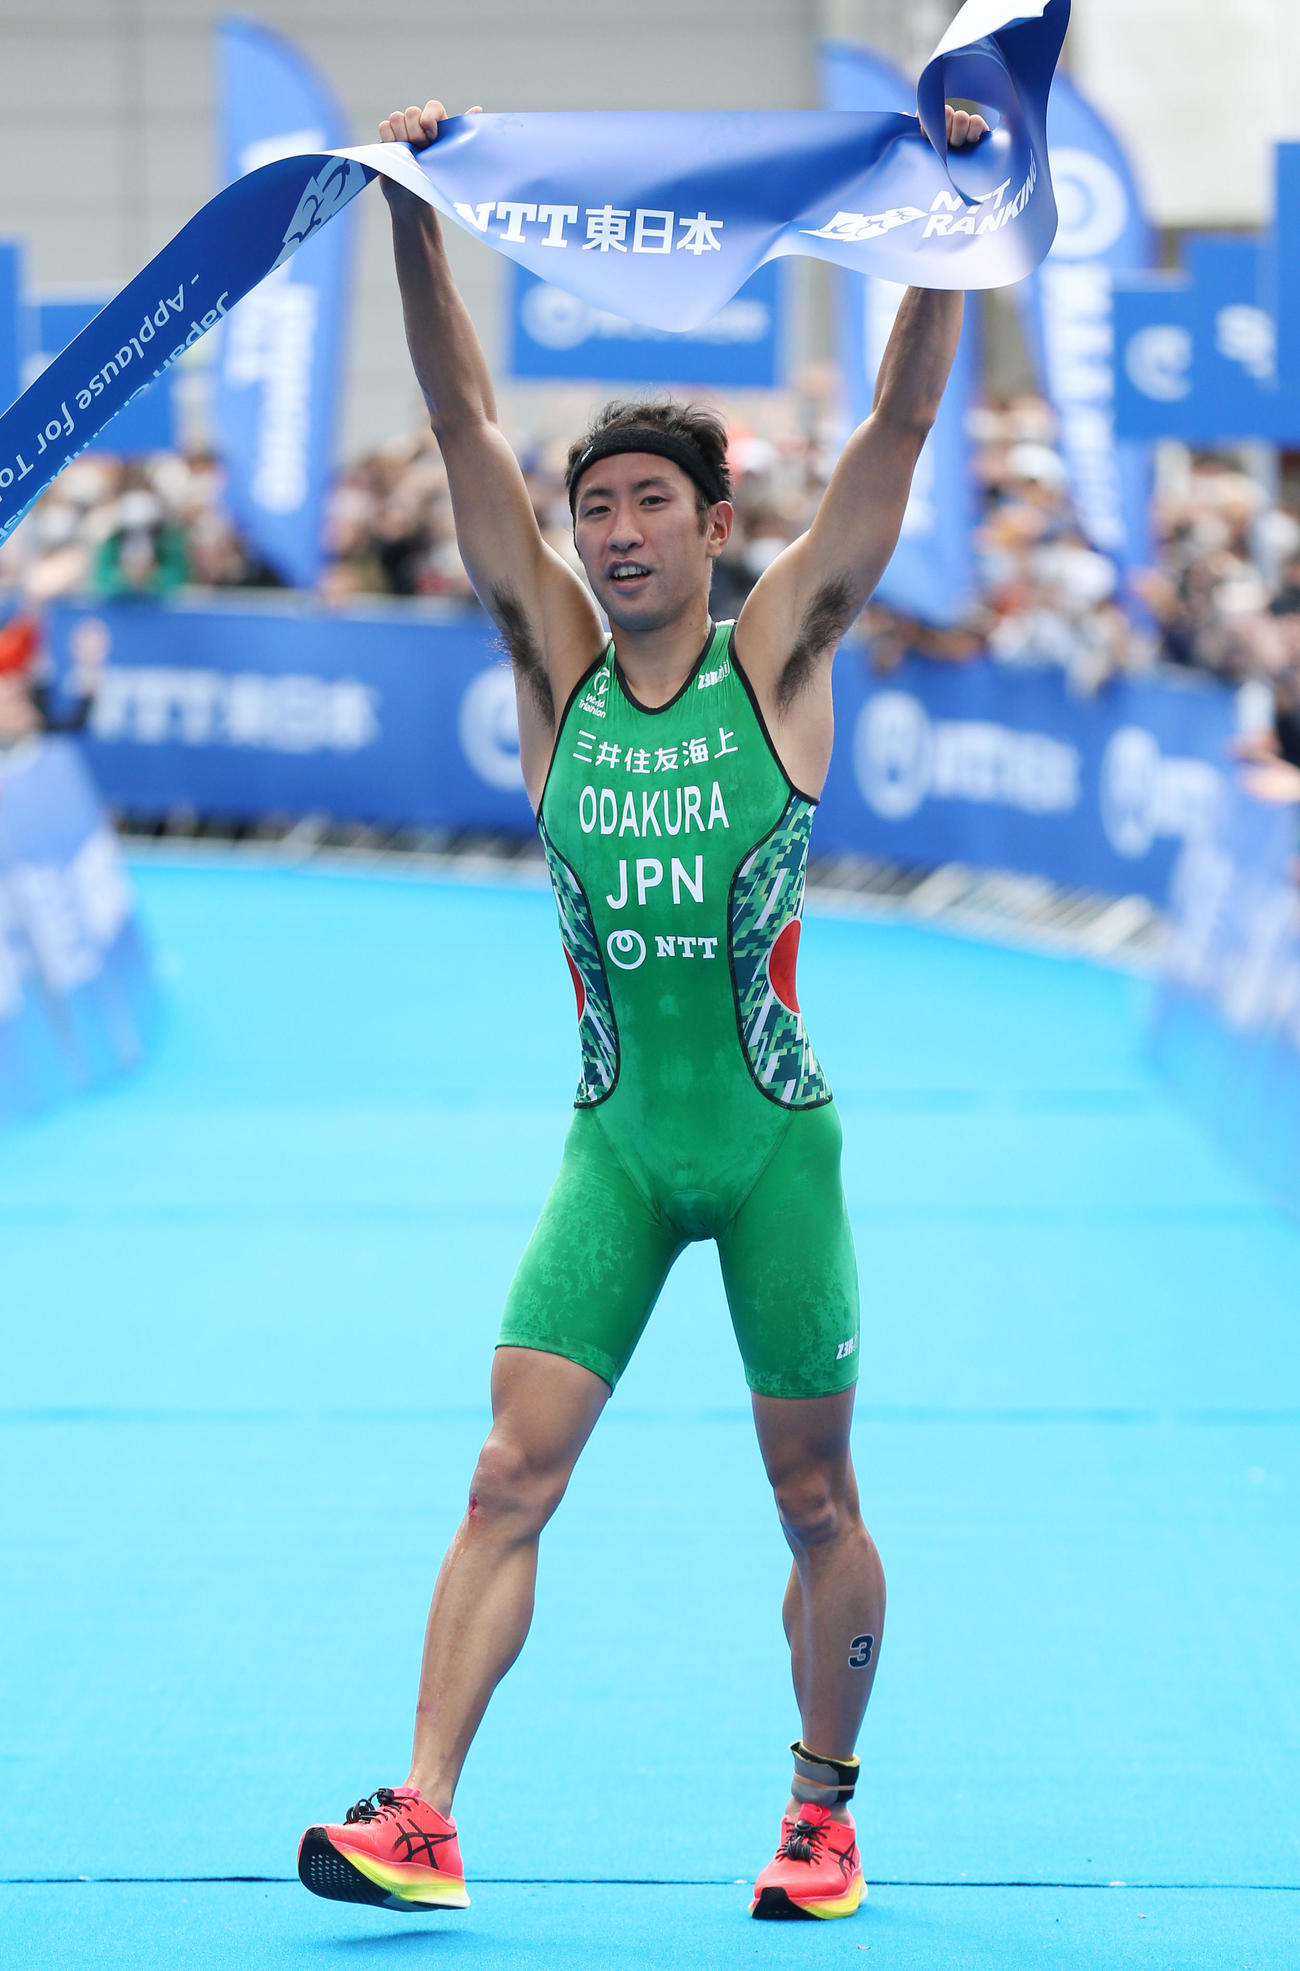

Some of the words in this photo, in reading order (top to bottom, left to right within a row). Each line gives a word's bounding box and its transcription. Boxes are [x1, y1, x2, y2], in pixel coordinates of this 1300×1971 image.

[581, 204, 724, 256] 東日本
[75, 284, 185, 410] Applause
[36, 401, 75, 454] for
[0, 454, 34, 502] To
[578, 698, 606, 719] Triathlon
[586, 692, 606, 708] World
[572, 727, 739, 774] 三井住友海上
[579, 781, 730, 838] ODAKURA
[606, 855, 705, 910] JPN
[655, 935, 719, 959] NTT
[848, 1633, 874, 1669] 3
